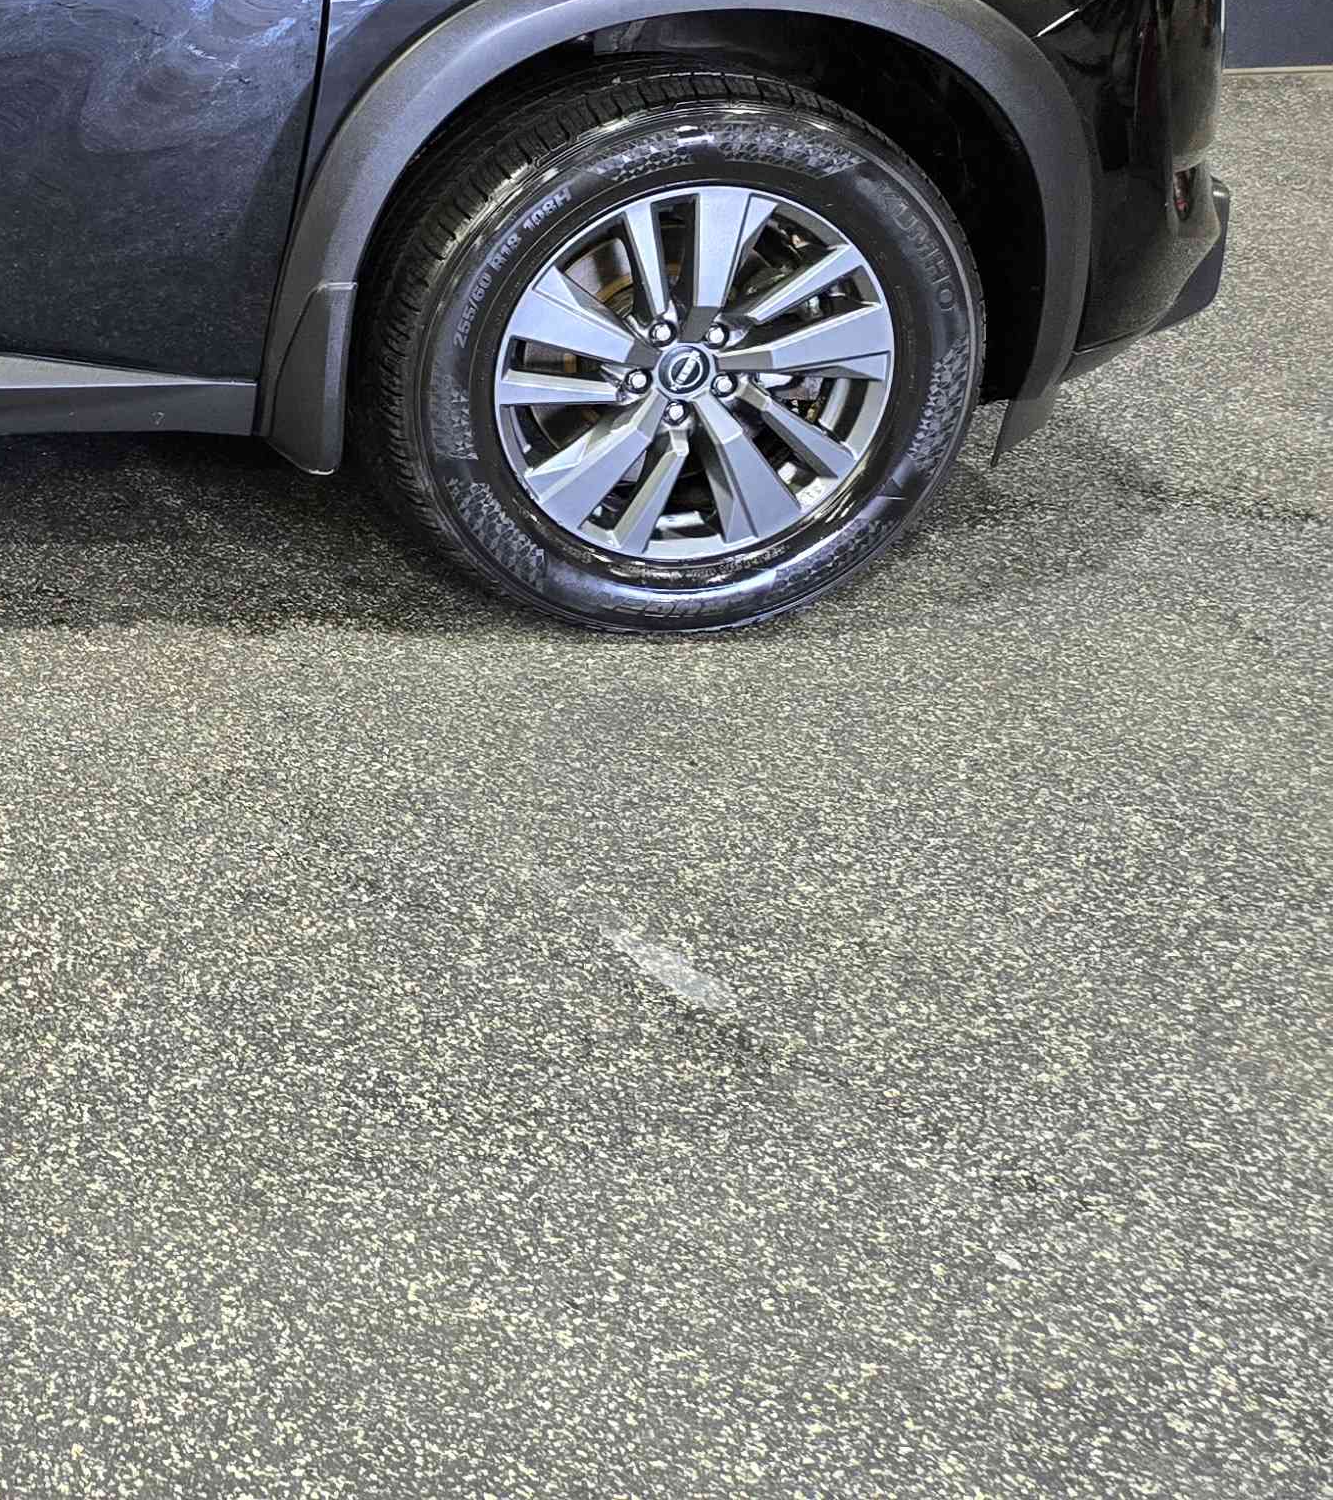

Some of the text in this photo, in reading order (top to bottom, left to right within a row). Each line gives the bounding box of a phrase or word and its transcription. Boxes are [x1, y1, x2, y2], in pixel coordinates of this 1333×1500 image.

[452, 186, 573, 350] 255/60 R18 108H
[877, 182, 958, 313] KUMHO
